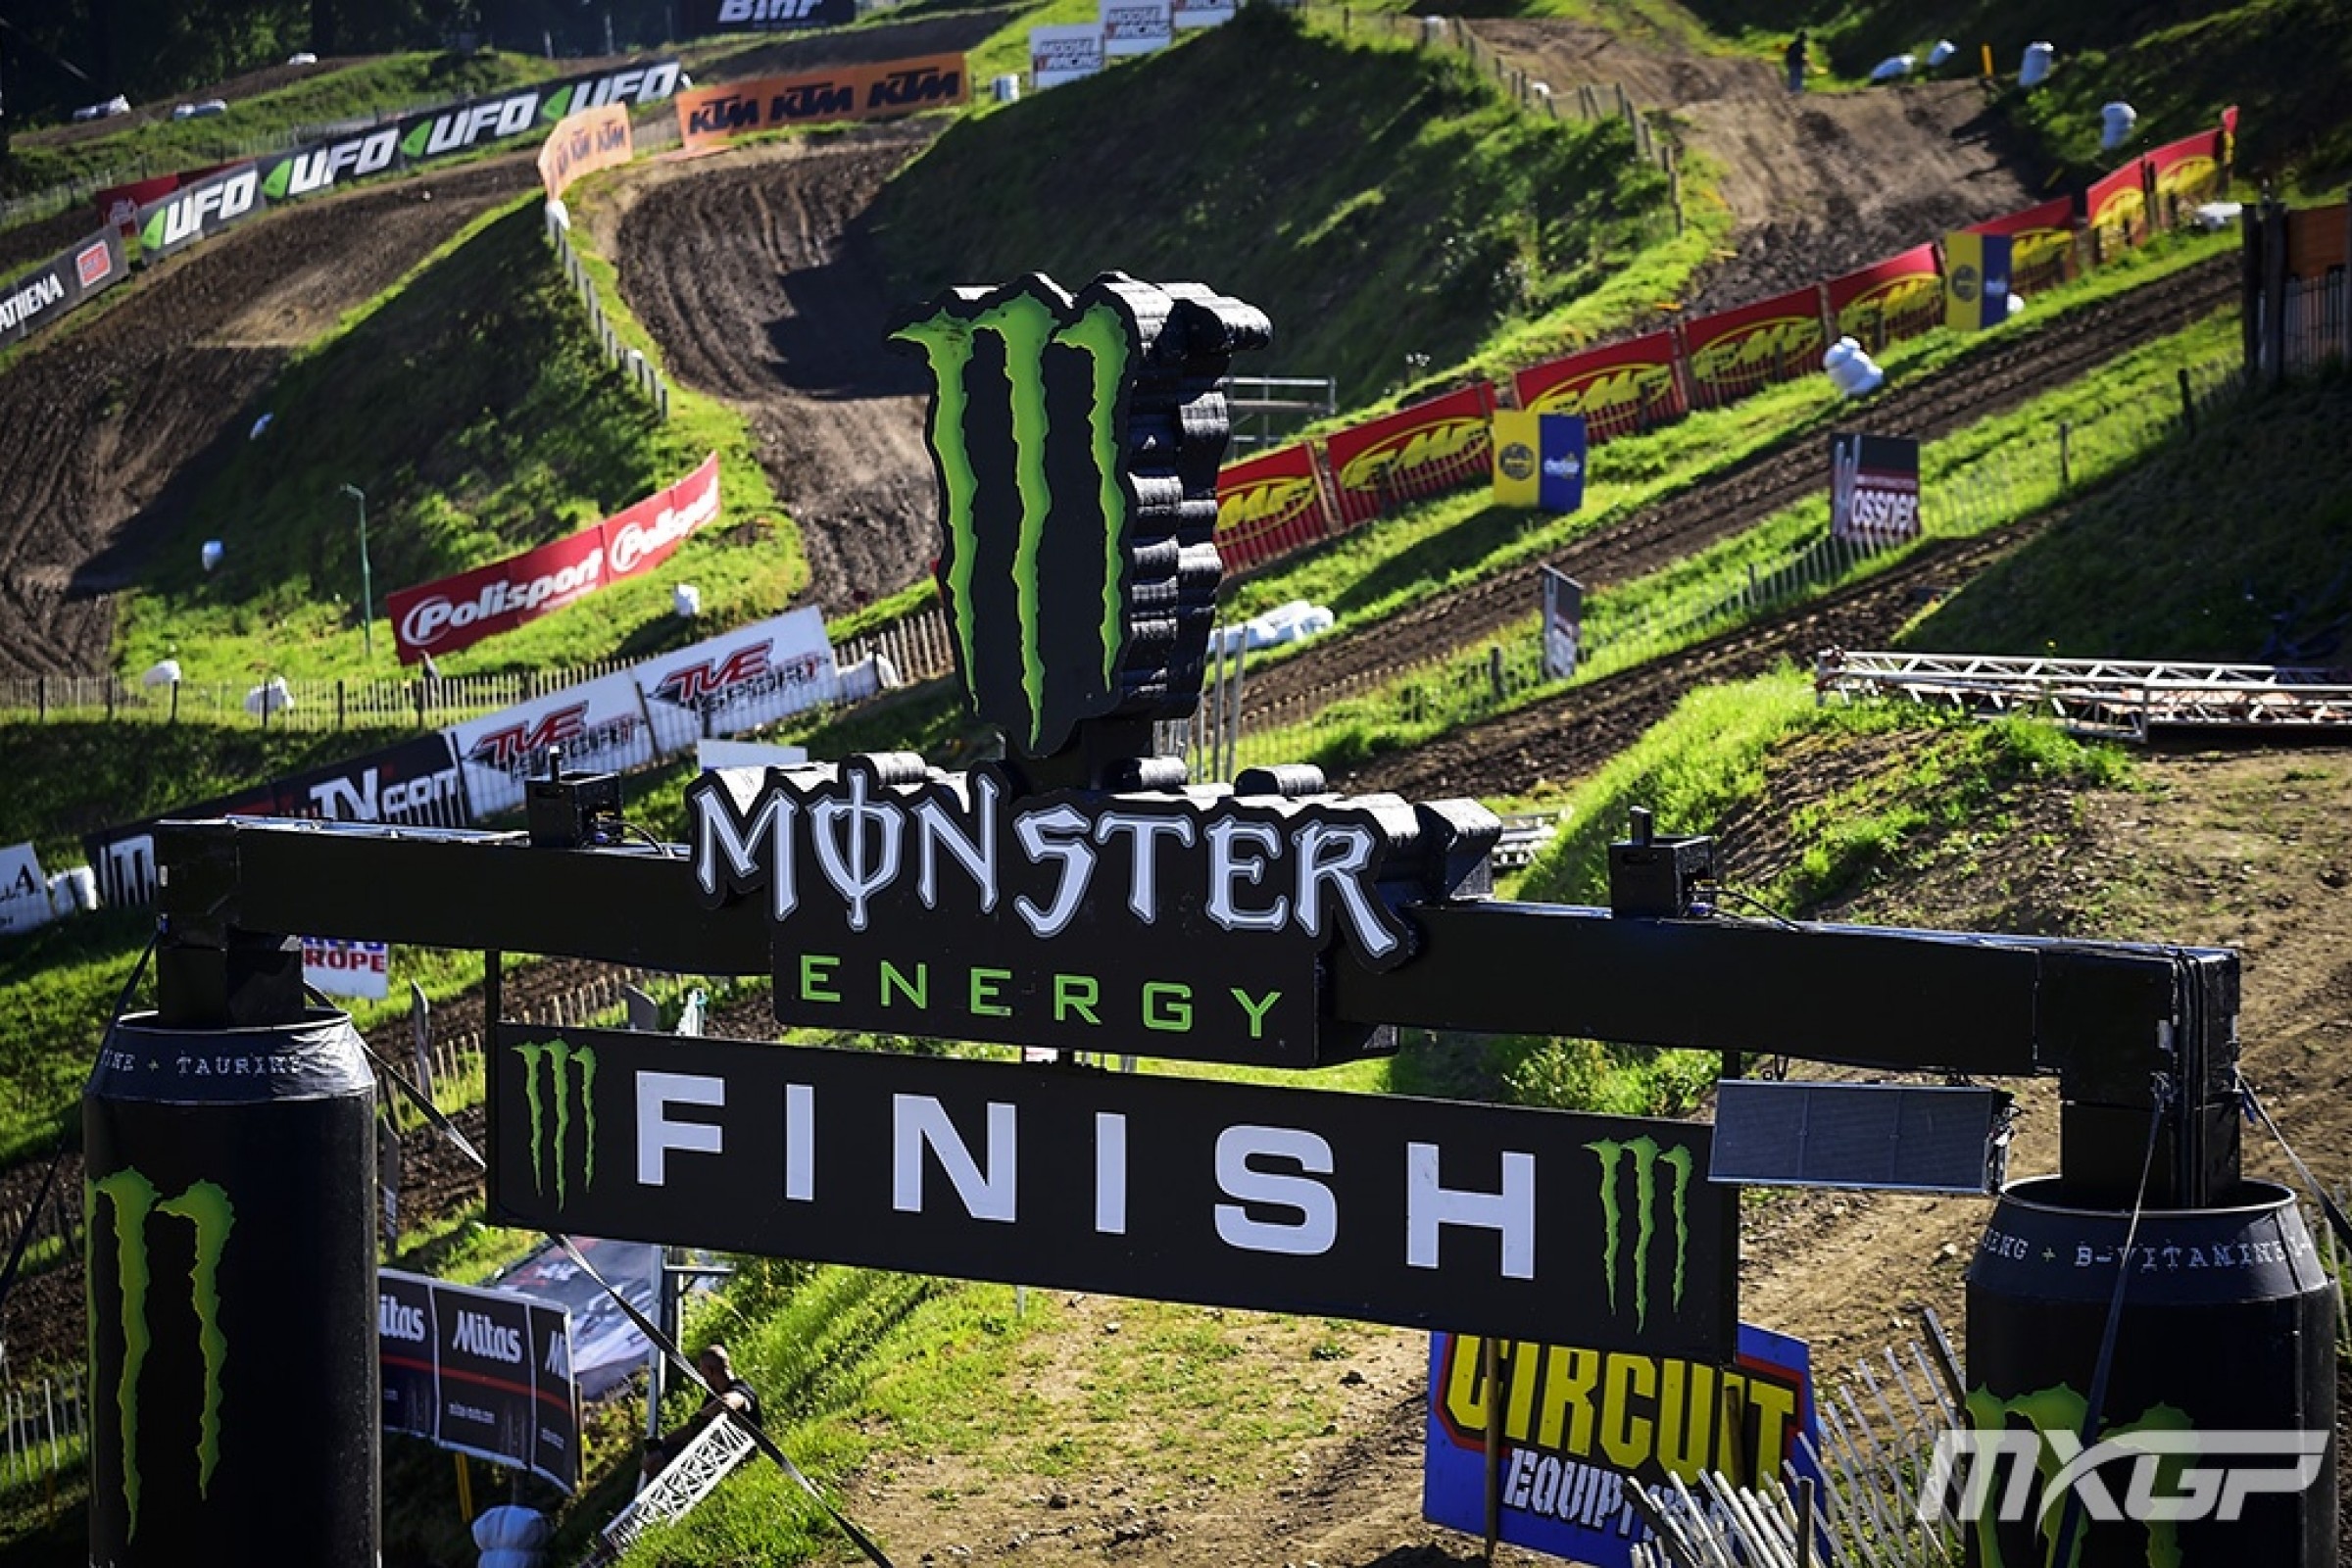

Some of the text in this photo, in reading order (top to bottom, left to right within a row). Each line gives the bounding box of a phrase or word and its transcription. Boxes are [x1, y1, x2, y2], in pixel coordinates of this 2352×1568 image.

[568, 62, 680, 115] UFO
[690, 95, 760, 133] KTM
[770, 83, 855, 120] KTM
[868, 68, 959, 107] KTM
[426, 92, 539, 155] UFO
[288, 129, 399, 195] UFO
[165, 171, 258, 245] UFO
[1342, 419, 1487, 490] FMF
[403, 547, 604, 645] Polisport
[692, 769, 1398, 957] MONSTER
[305, 947, 386, 973] ROPE
[800, 955, 1281, 1039] ENERGY
[635, 1070, 1536, 1280] FINISH
[379, 1296, 425, 1343] itas
[452, 1309, 522, 1363] Mitas
[1447, 1335, 1795, 1499] CIRCUIT
